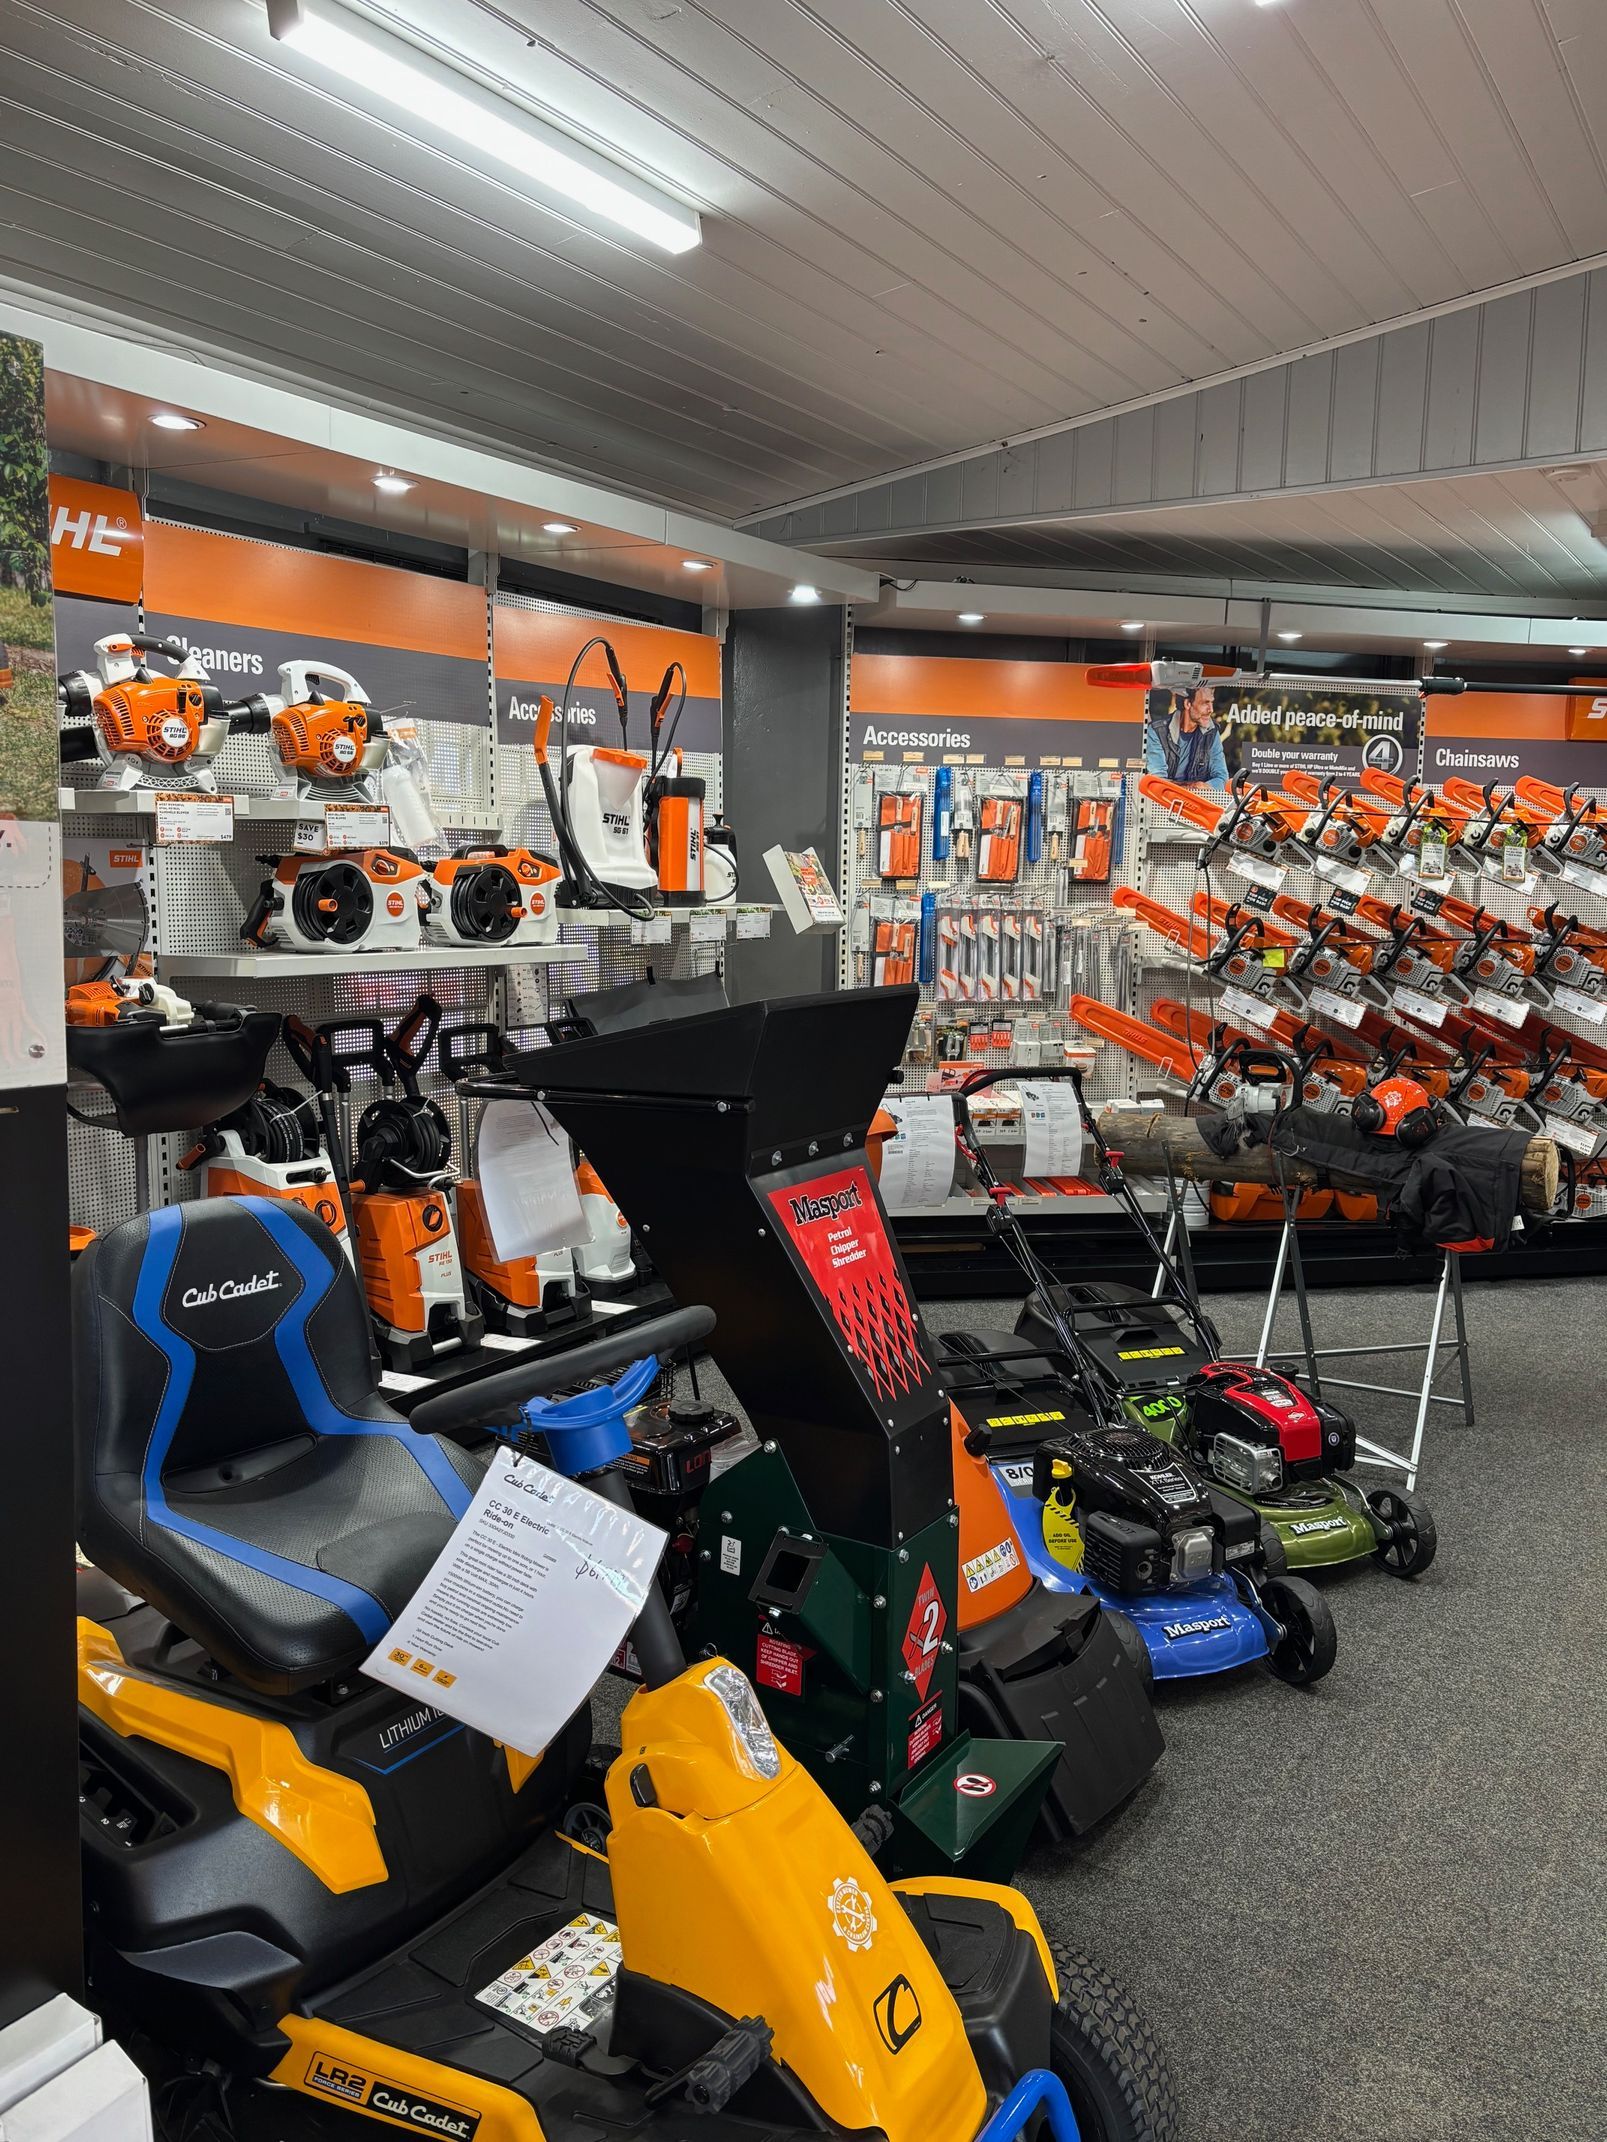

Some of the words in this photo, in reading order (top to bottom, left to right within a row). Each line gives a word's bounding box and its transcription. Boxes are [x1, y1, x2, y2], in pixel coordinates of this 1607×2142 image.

[50, 506, 122, 556] HL
[166, 635, 263, 675] Cleaners
[1226, 703, 1282, 725] Added
[1285, 709, 1403, 731] peace-of-mind
[163, 726, 187, 734] STIHL
[863, 726, 970, 748] Accessories
[1252, 748, 1280, 759] Double
[1282, 751, 1299, 761] your
[1301, 752, 1338, 763] warranty
[1436, 748, 1520, 768] Chainsaws
[299, 824, 319, 832] SAVE
[602, 813, 630, 826] STIHL
[788, 1180, 862, 1226] Masport
[828, 1226, 852, 1242] Petrol
[428, 1250, 452, 1264] STIHL
[830, 1240, 859, 1255] Chipper
[832, 1249, 866, 1268] Shredder
[182, 1284, 217, 1307] Cub
[219, 1270, 279, 1300] Cadet
[504, 1474, 523, 1488] Cub
[482, 1508, 515, 1529] Ride-on
[488, 1499, 502, 1510] CC
[501, 1505, 513, 1516] 30
[519, 1515, 550, 1535] Electric
[1290, 1516, 1346, 1534] Masport
[918, 1586, 934, 1606] TWIN
[1164, 1616, 1231, 1638] Masport
[762, 1643, 781, 1652] CUTTING
[772, 1652, 788, 1660] HANDS
[760, 1660, 784, 1670] SHREDDER
[768, 1656, 788, 1666] CHIPPER
[922, 1703, 937, 1719] DANGER
[379, 1707, 431, 1748] LITHIUM
[315, 2062, 366, 2088] LR2
[313, 2076, 335, 2088] FORCE
[336, 2085, 360, 2097] SERIES
[372, 2092, 409, 2115] Cub
[410, 2105, 469, 2138] Cadet
